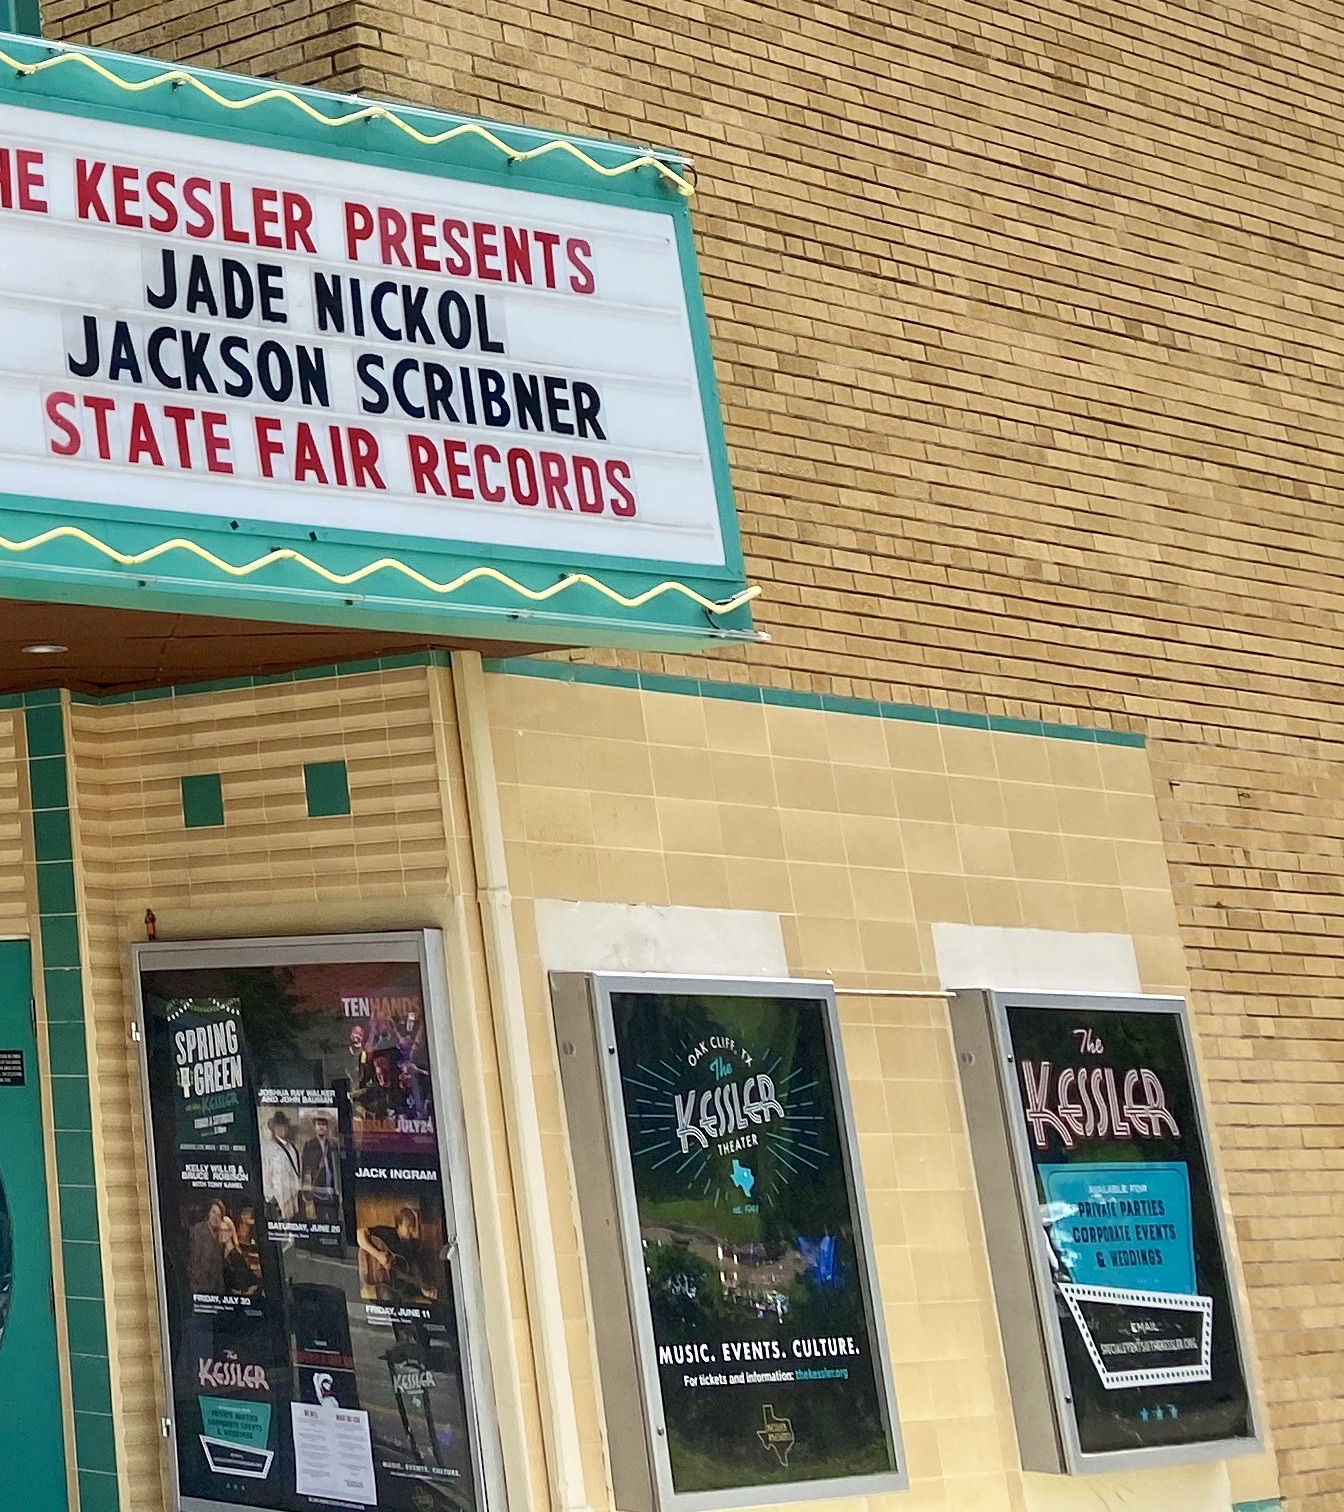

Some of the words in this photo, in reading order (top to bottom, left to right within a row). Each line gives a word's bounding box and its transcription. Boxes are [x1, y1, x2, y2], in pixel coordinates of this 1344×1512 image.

[74, 157, 318, 254] KESSLER
[343, 200, 596, 295] PRESENTS
[145, 248, 288, 325] JADE
[313, 271, 505, 354] NICKOL
[67, 315, 330, 408] JACKSON
[357, 352, 608, 442] SCRIBNER
[43, 390, 235, 475] STATE
[253, 415, 388, 490] FAIR
[408, 433, 637, 518] RECORDS
[342, 997, 370, 1017] TEN
[175, 1019, 238, 1065] SPRING
[1072, 1028, 1104, 1055] The
[687, 1040, 709, 1068] OAK
[740, 1047, 755, 1068] TX
[194, 1054, 243, 1097] GREEN
[709, 1055, 734, 1082] The
[261, 1096, 278, 1104] AND
[279, 1096, 300, 1104] JOHN
[305, 1089, 335, 1097] WALKER
[674, 1073, 785, 1154] KESSLER
[1022, 1061, 1181, 1149] KESSLER
[717, 1133, 759, 1157] THEATER
[185, 1164, 209, 1172] KELLY
[355, 1167, 388, 1179] JACK
[389, 1169, 437, 1181] INGRAM
[1129, 1184, 1148, 1194] FOR
[1077, 1200, 1118, 1217] PRIVATE
[1118, 1199, 1166, 1217] PARTIES
[310, 1223, 330, 1233] JUNE
[1072, 1225, 1132, 1243] CORPORATE
[1134, 1223, 1177, 1241] EVENTS
[1095, 1251, 1107, 1268] &
[1109, 1248, 1164, 1267] WEDDINGS
[240, 1297, 251, 1306] 30
[397, 1307, 421, 1318] JUNE
[421, 1309, 431, 1319] 11
[658, 1343, 716, 1365] MUSIC.
[721, 1340, 787, 1362] EVENTS.
[792, 1337, 861, 1359] CULTURE.
[198, 1357, 270, 1391] KESSLER
[393, 1371, 437, 1392] KESSLER
[683, 1375, 699, 1388] For
[698, 1373, 728, 1387] tickets
[728, 1371, 746, 1385] and
[746, 1369, 795, 1384] information:
